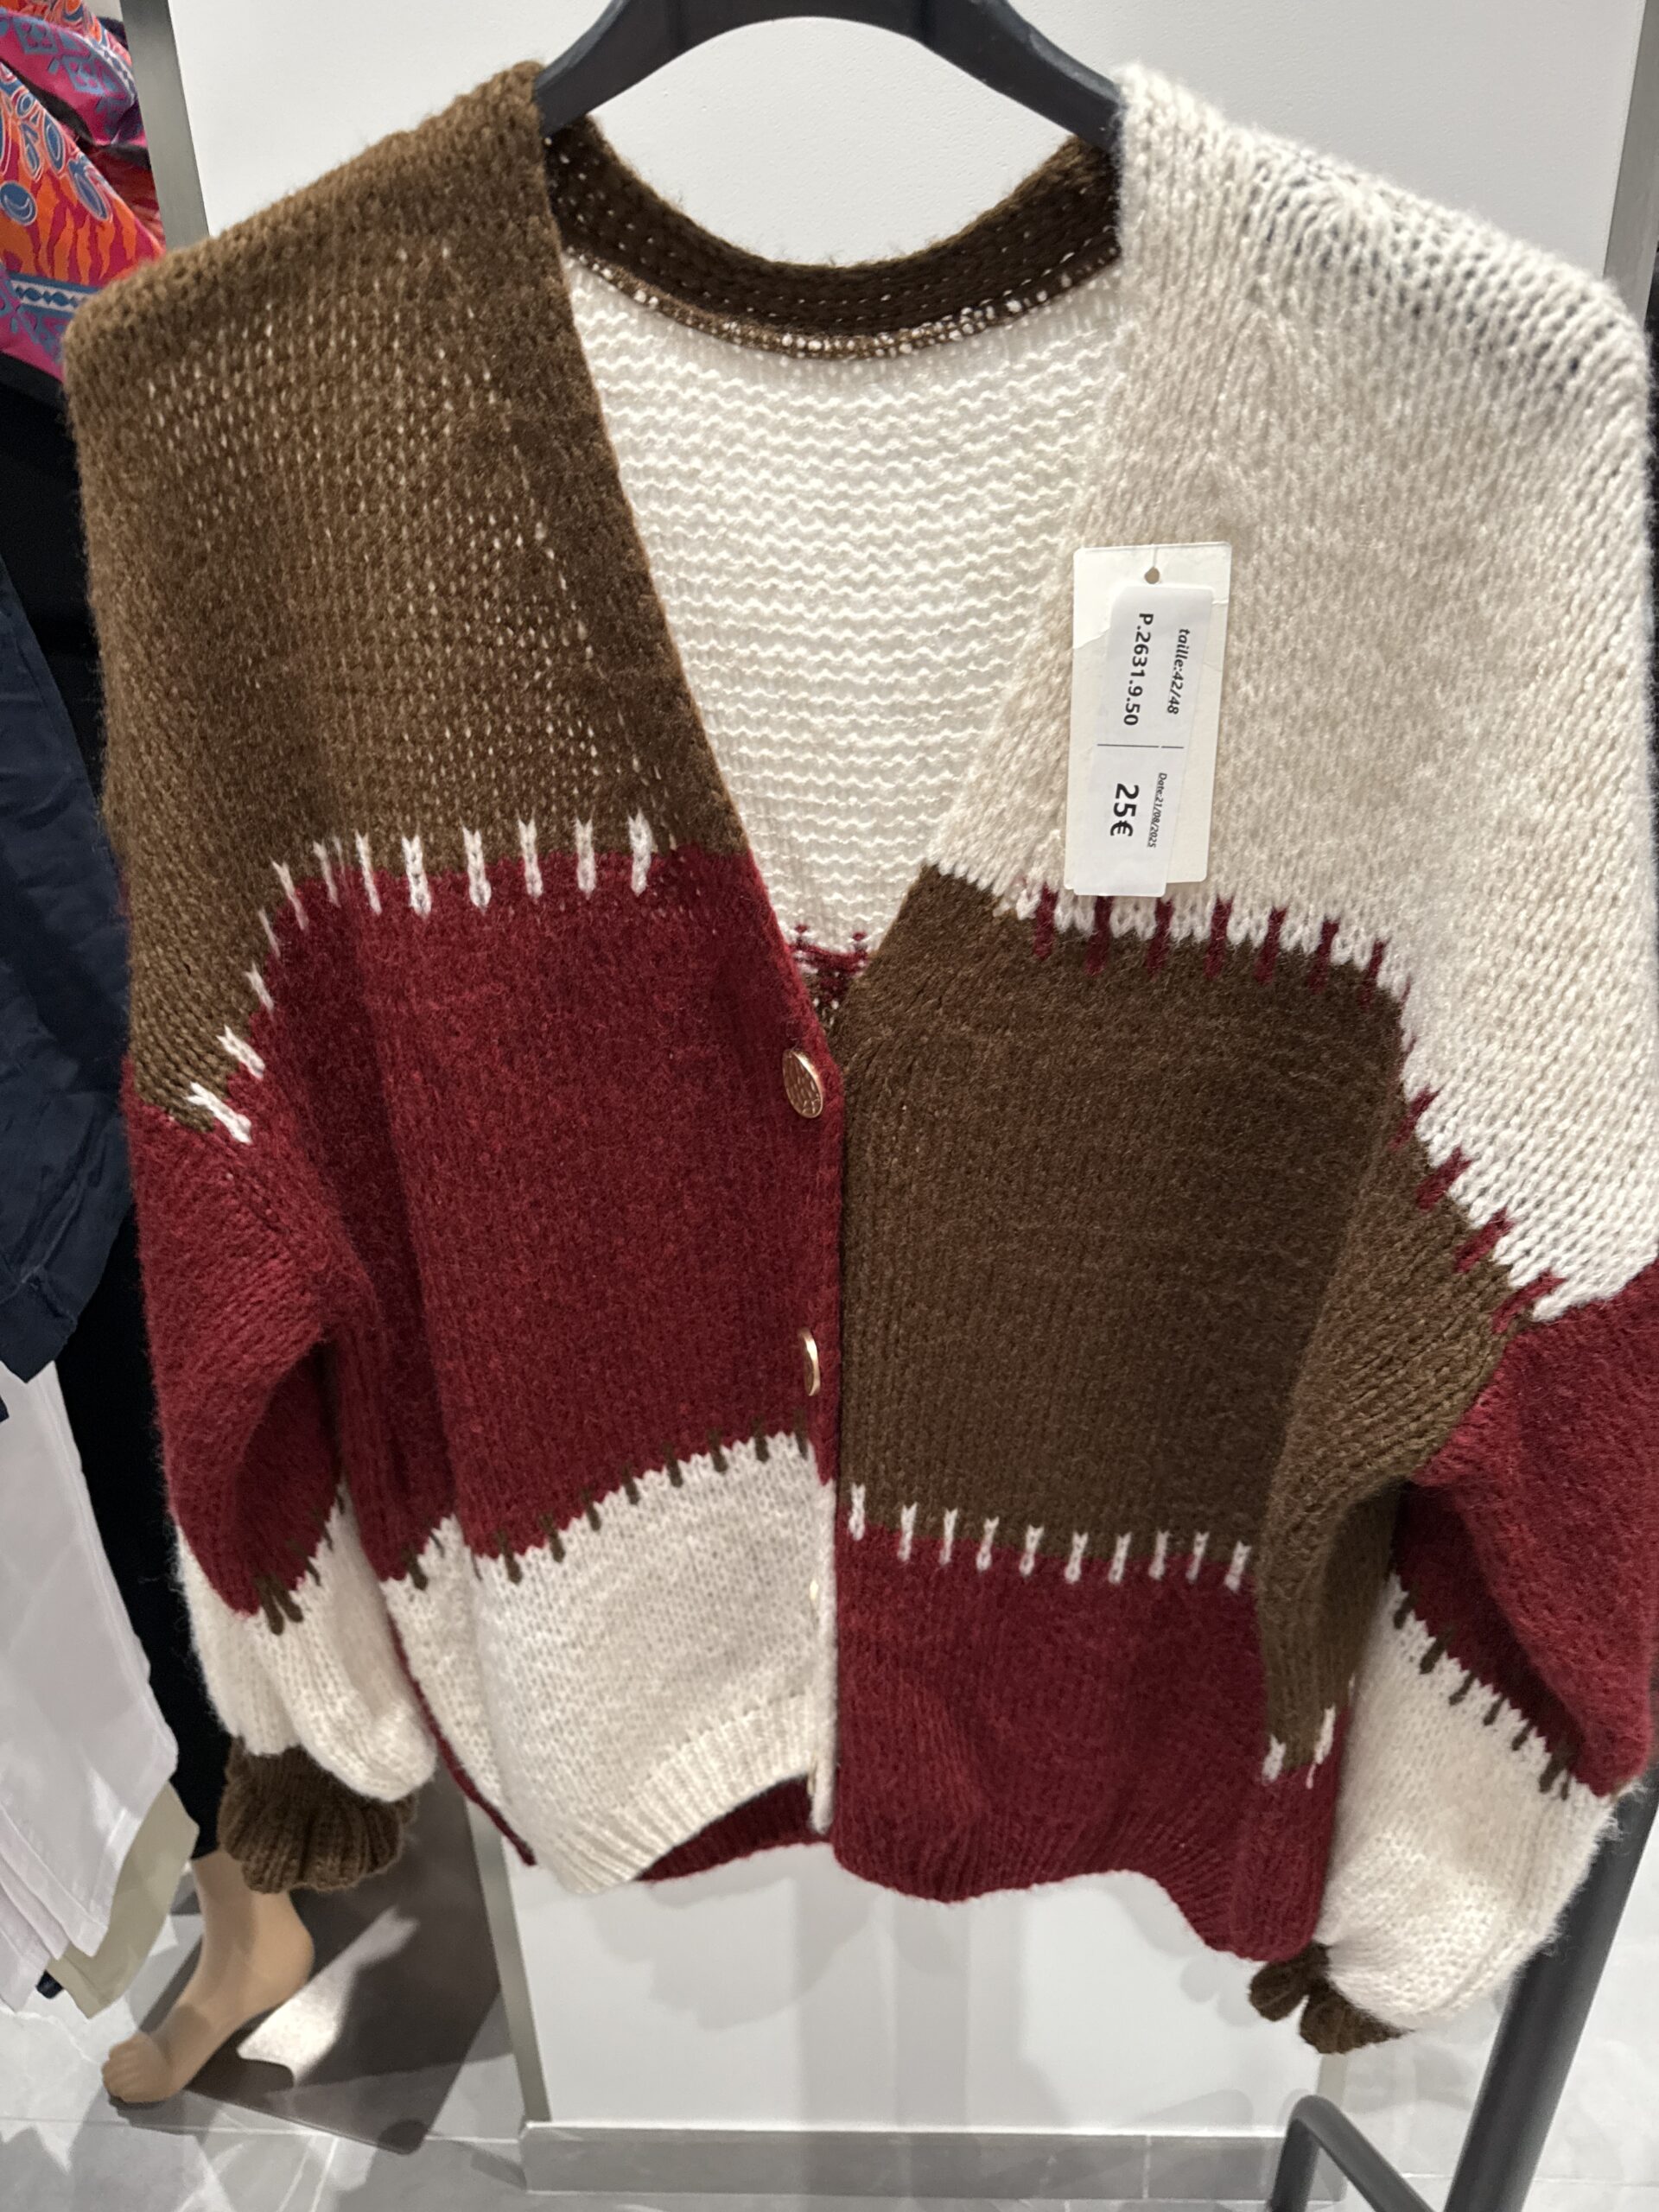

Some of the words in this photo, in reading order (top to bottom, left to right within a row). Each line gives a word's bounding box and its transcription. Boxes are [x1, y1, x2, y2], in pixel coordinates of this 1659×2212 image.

[1123, 613, 1154, 726] P.2631.9.50
[1166, 628, 1191, 715] taille:42/48
[1109, 783, 1140, 837] 25€
[1147, 772, 1167, 849] Date:21/08/2025
